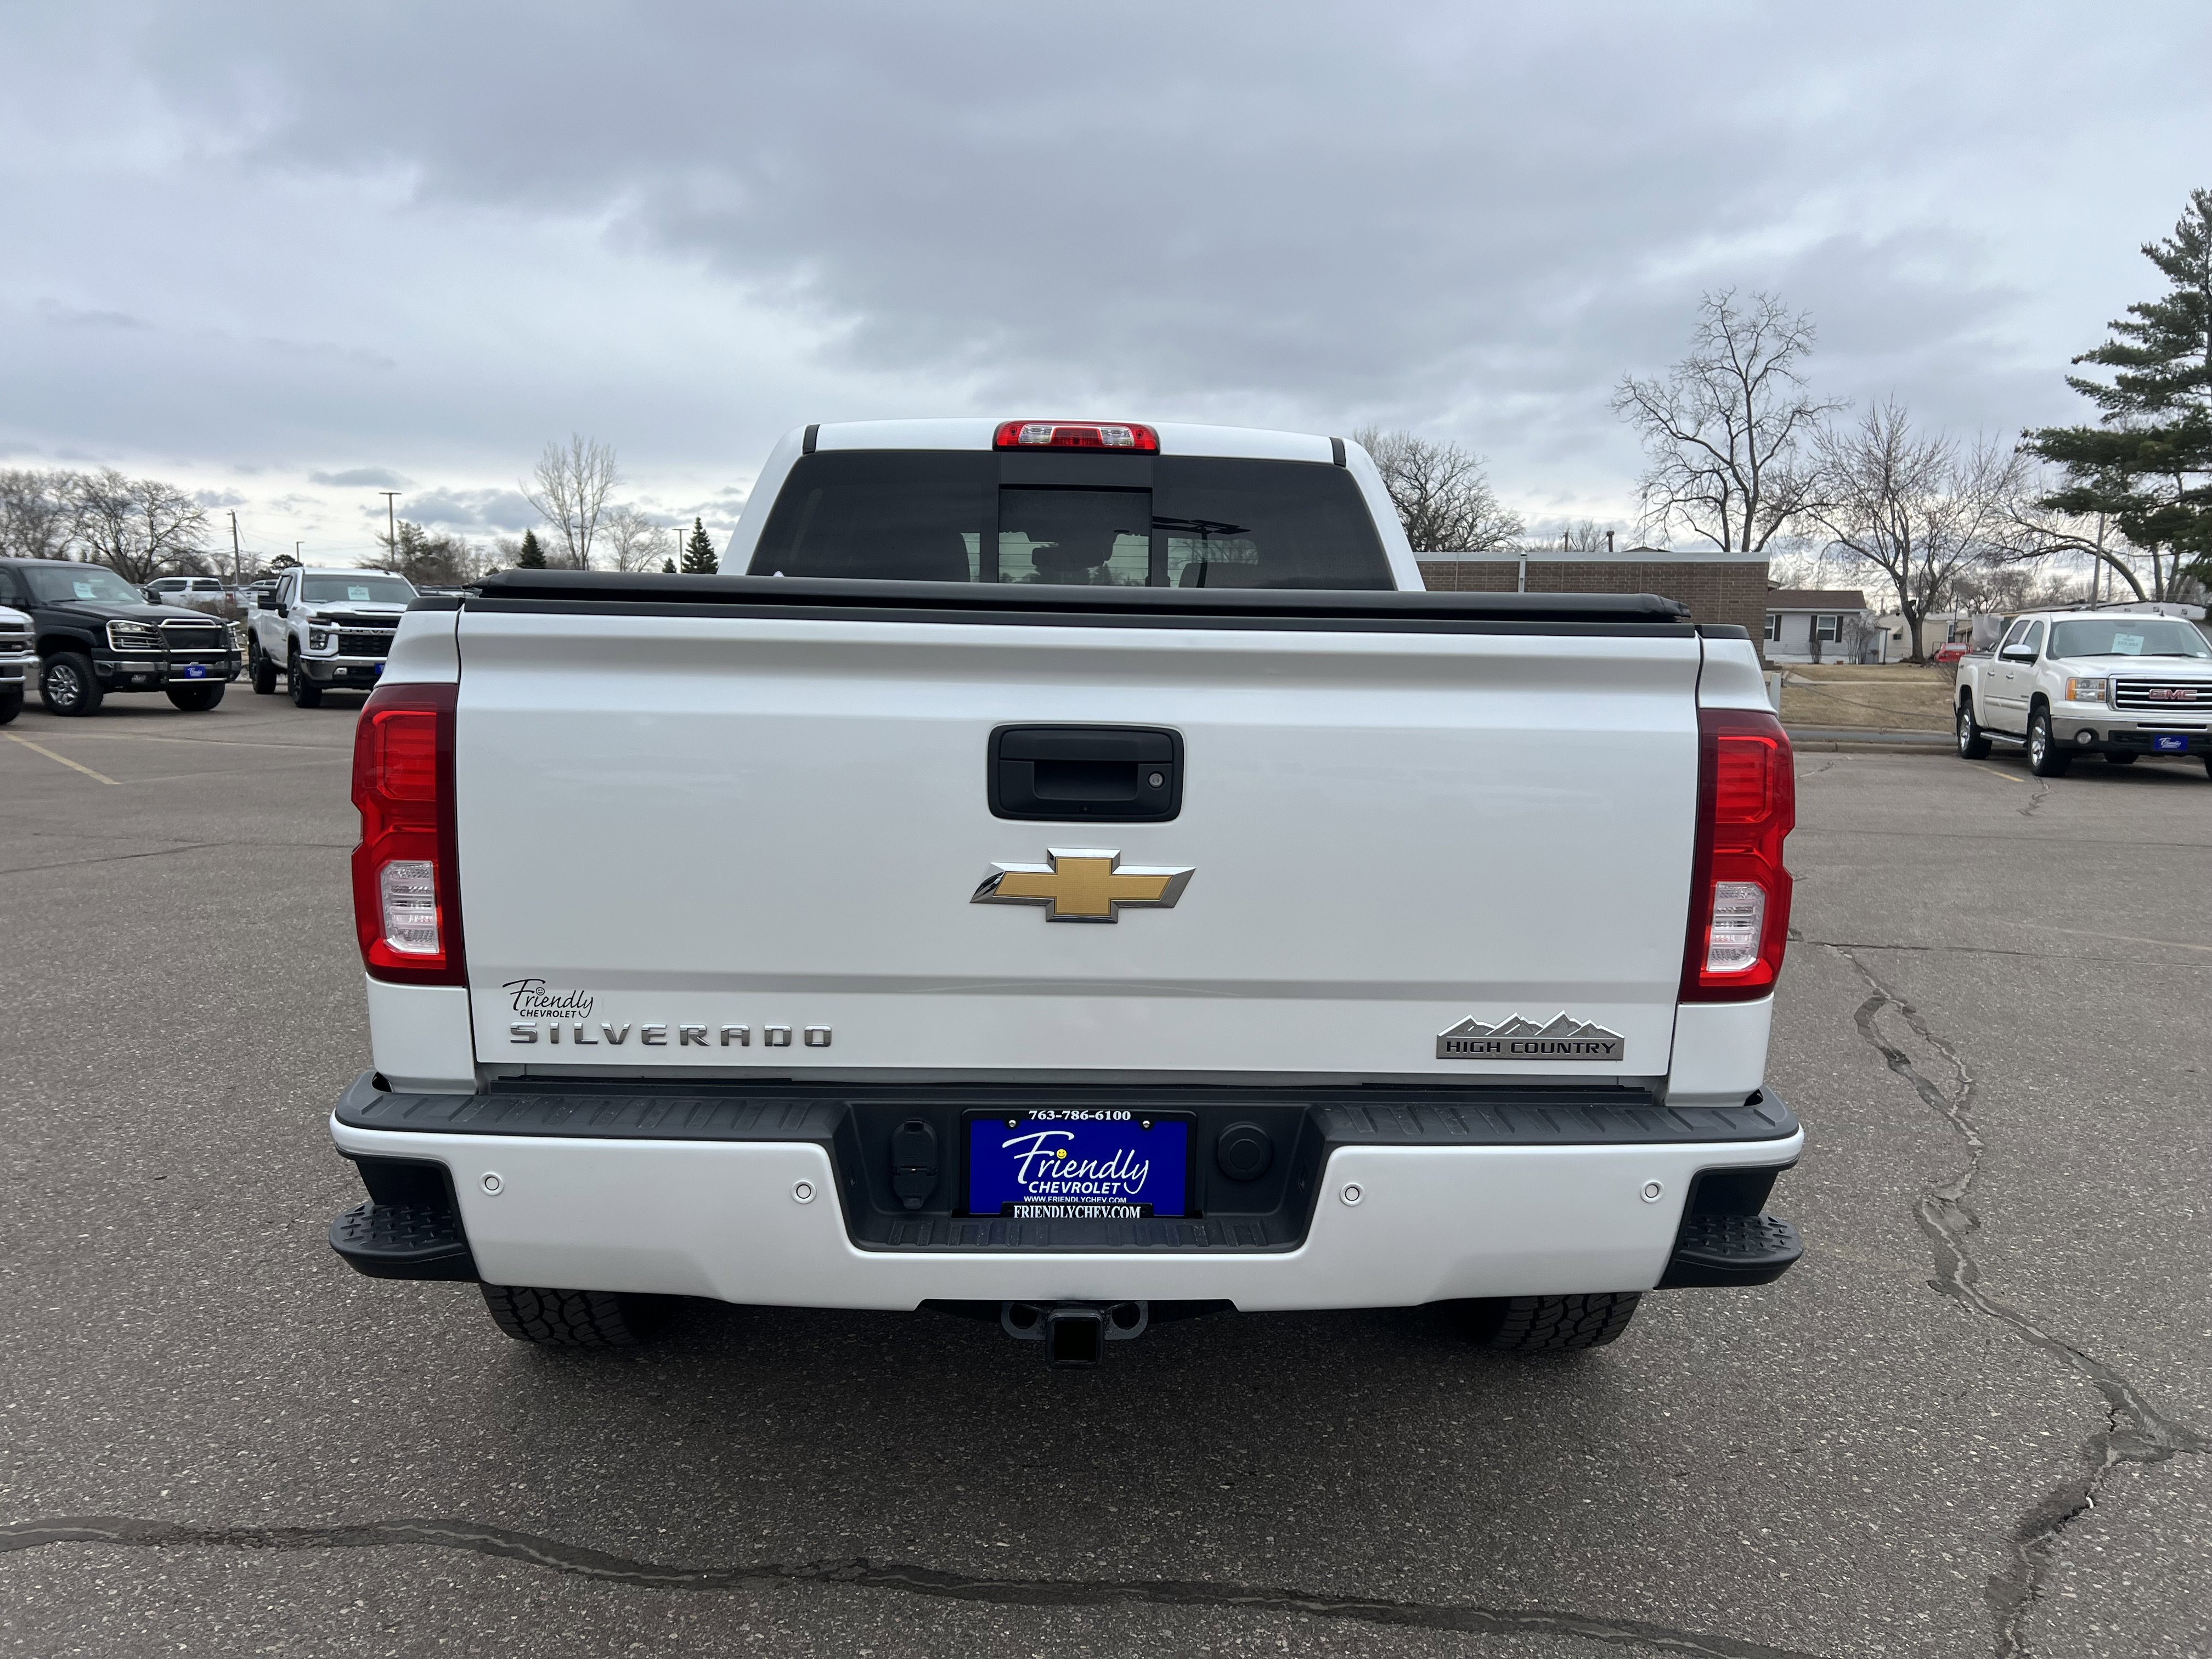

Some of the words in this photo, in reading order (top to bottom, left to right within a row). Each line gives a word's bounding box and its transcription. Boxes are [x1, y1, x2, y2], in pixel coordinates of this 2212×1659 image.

[2149, 689, 2198, 700] GMC
[502, 979, 594, 1018] Friendly
[520, 1009, 577, 1018] CHEVROLET
[510, 1021, 832, 1047] SILVERADO
[1447, 1041, 1500, 1053] HIGH
[1510, 1042, 1616, 1054] COUNTRY
[1028, 1110, 1131, 1121] 763-786-6100
[1002, 1131, 1149, 1194] Friendly
[1028, 1181, 1121, 1194] CHEVROLET
[1013, 1205, 1141, 1218] FRIENDLYCHEV.COM
